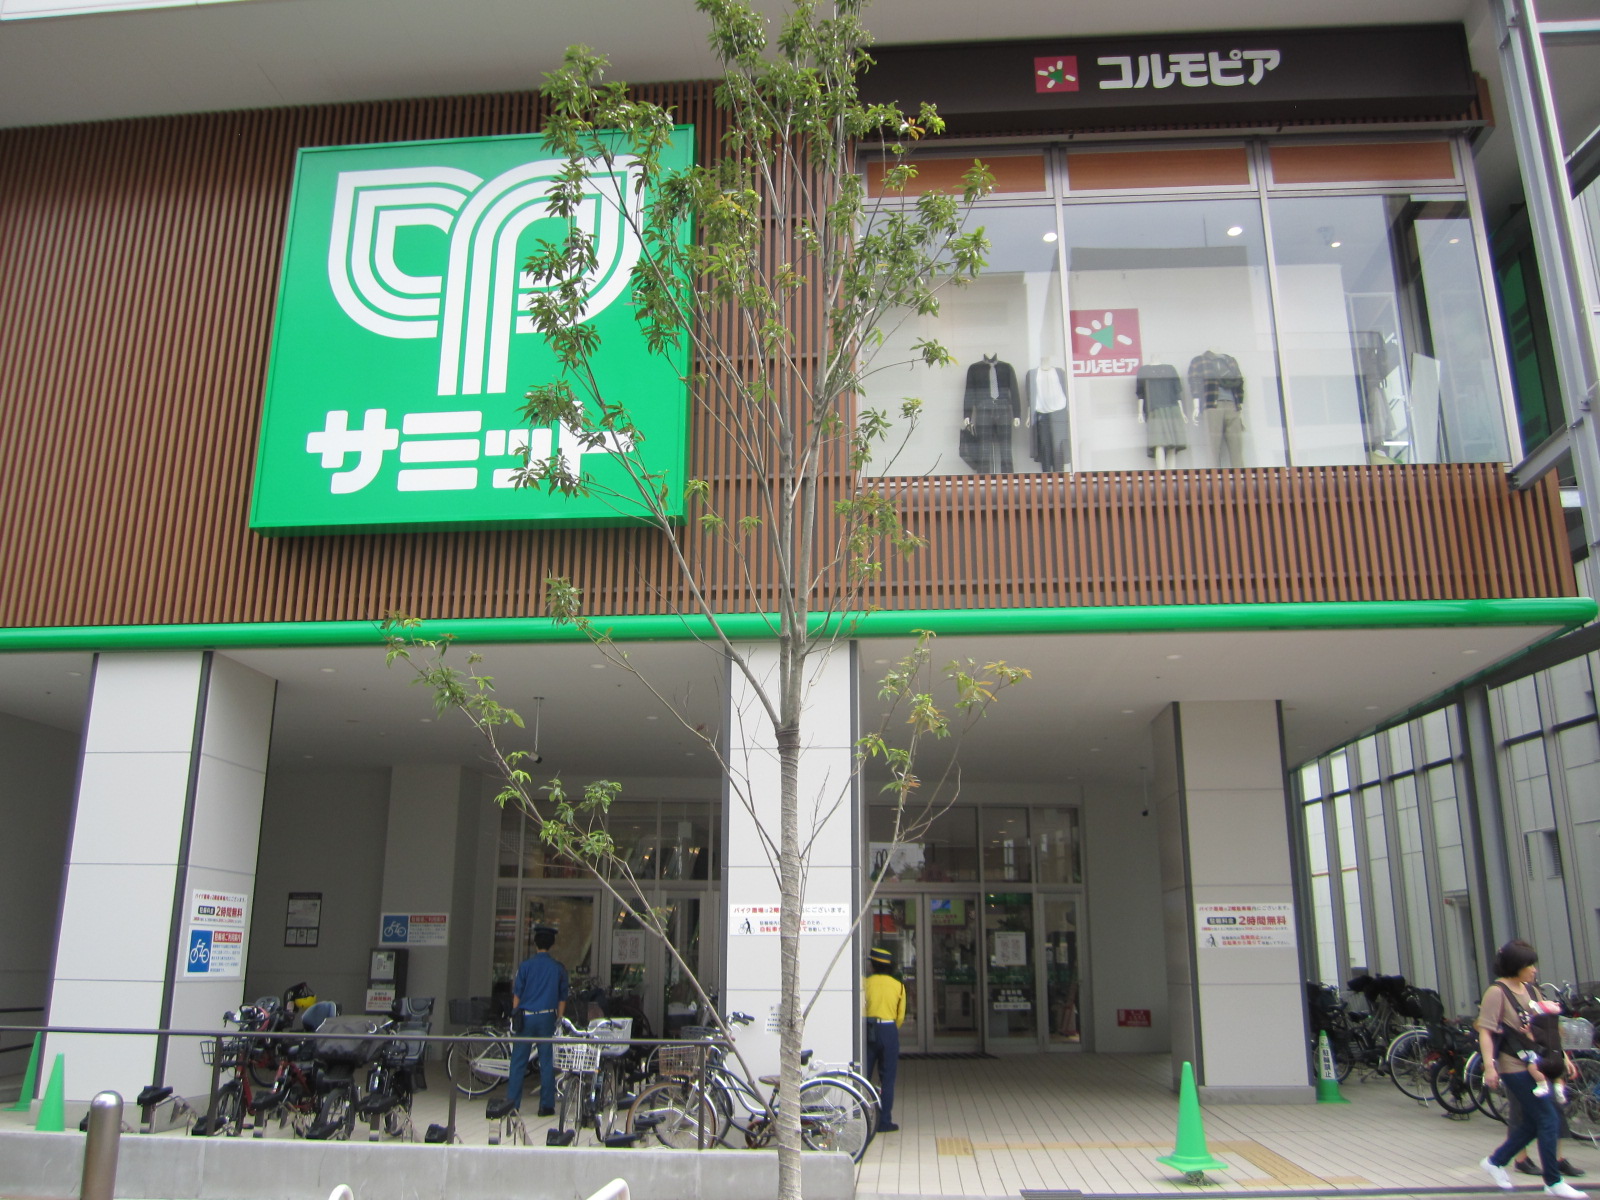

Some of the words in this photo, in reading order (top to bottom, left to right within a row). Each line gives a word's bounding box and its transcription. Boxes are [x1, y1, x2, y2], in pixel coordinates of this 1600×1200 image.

[1097, 50, 1280, 90] コルモピア
[1072, 358, 1140, 374] コルモピア
[306, 401, 635, 495] サミット
[1238, 915, 1286, 926] 2時間無料
